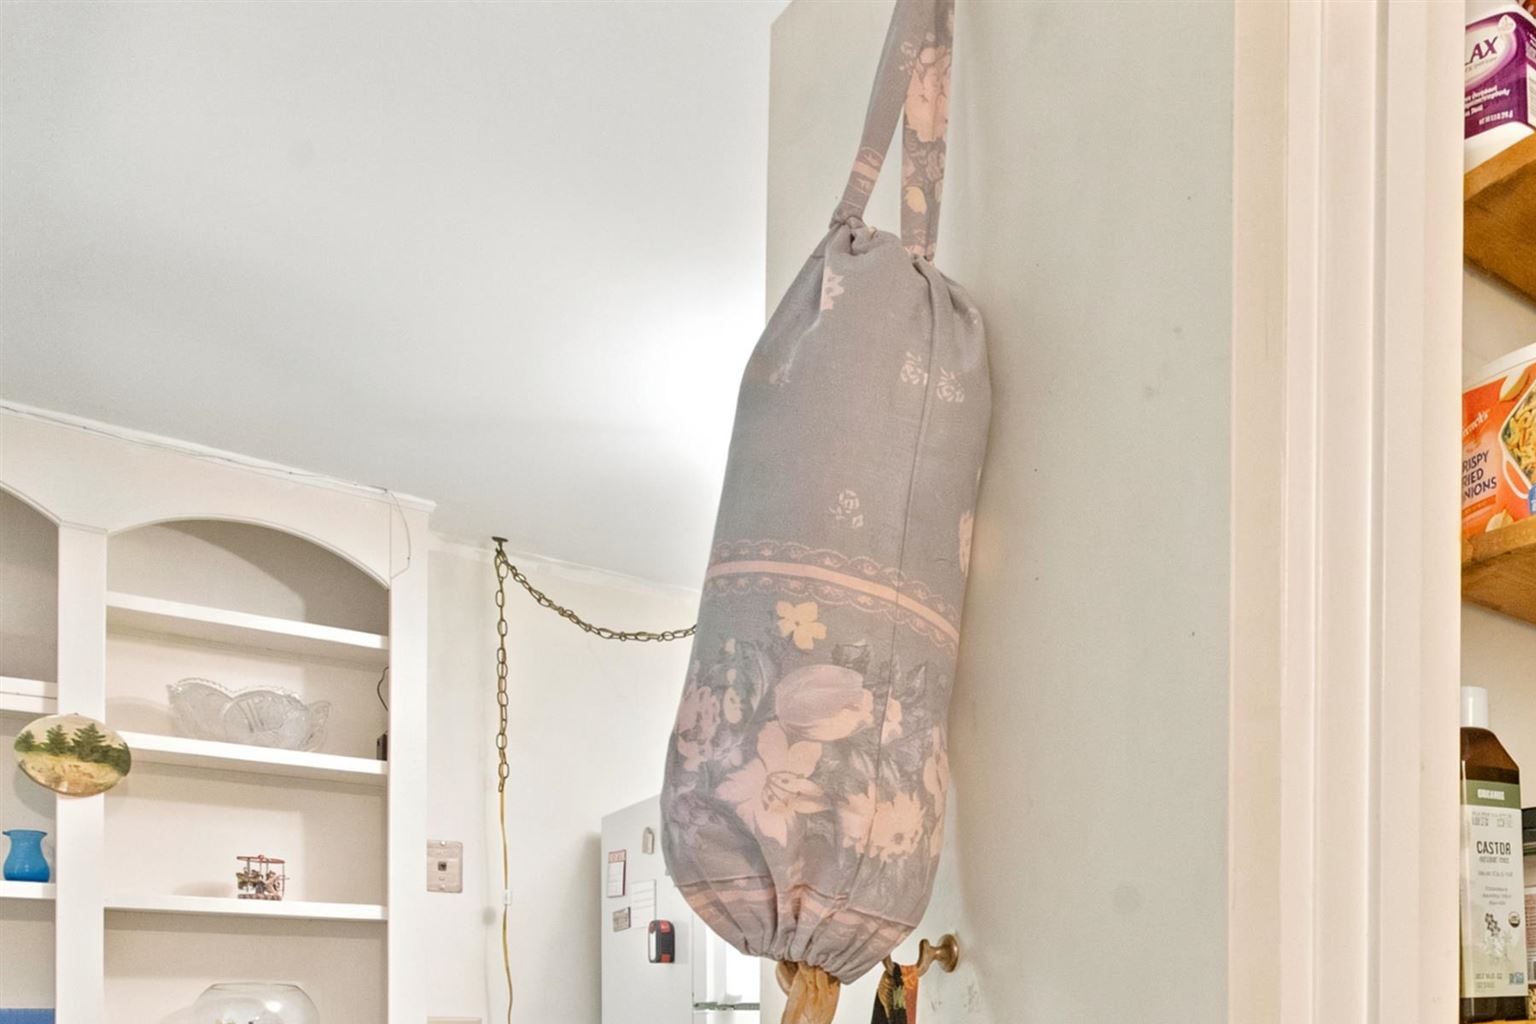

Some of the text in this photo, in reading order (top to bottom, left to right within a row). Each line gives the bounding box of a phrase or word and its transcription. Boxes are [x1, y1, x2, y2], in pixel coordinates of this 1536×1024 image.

[1462, 450, 1490, 470] RISPY
[1464, 476, 1498, 499] NIONS
[1476, 840, 1512, 856] CASTOR
